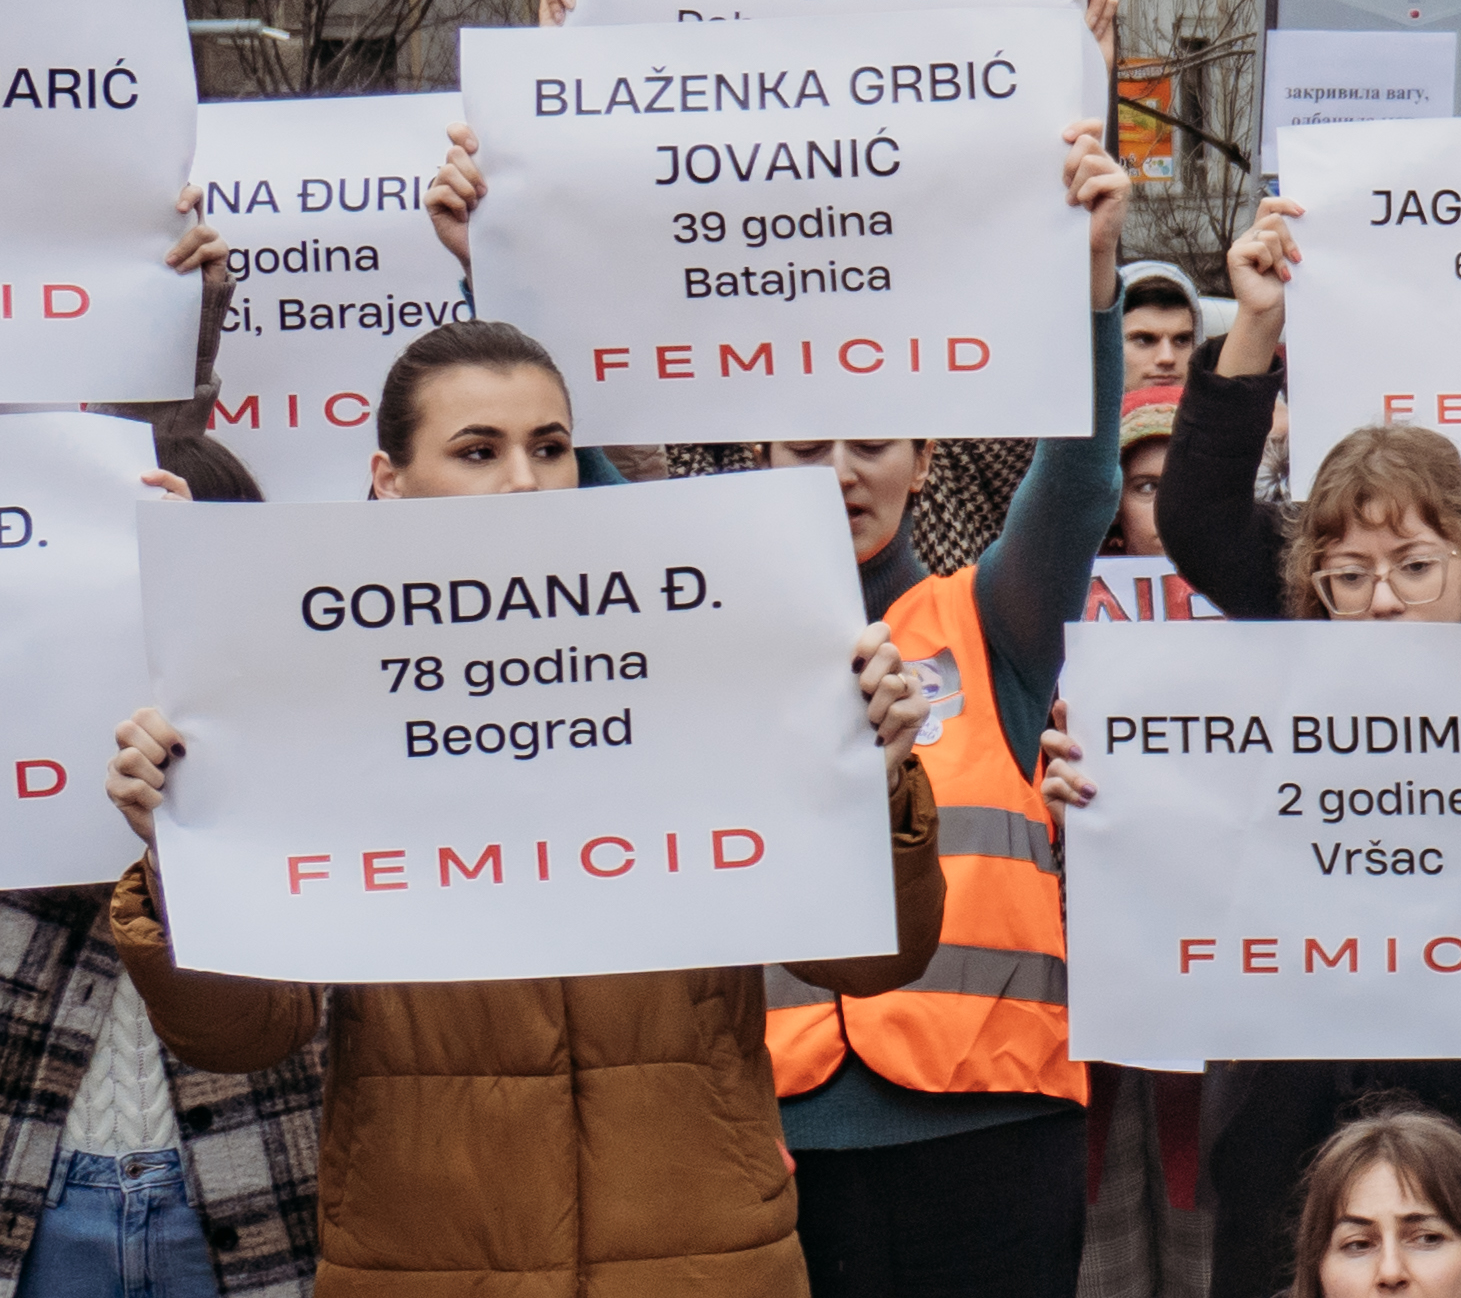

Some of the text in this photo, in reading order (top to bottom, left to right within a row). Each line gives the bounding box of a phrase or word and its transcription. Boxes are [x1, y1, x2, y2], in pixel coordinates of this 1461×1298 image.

[2, 57, 141, 112] ARIĆ
[536, 51, 1016, 116] BLAŽENKA GRBIĆ
[1288, 87, 1429, 104] закривила вагу,
[656, 128, 900, 185] JOVANIĆ
[297, 176, 431, 212] ĐURI
[673, 206, 892, 248] 39 godina
[227, 239, 379, 281] godina
[685, 261, 890, 301] Batajnica
[594, 338, 989, 381] FEMICID
[302, 567, 721, 631] GORDANA Đ.
[381, 646, 647, 696] 78 godina
[406, 708, 631, 760] Beograd
[1107, 716, 1273, 754] PETRA
[1278, 783, 1302, 816] 2
[289, 829, 764, 894] FEMICID
[1312, 840, 1443, 876] Vršac
